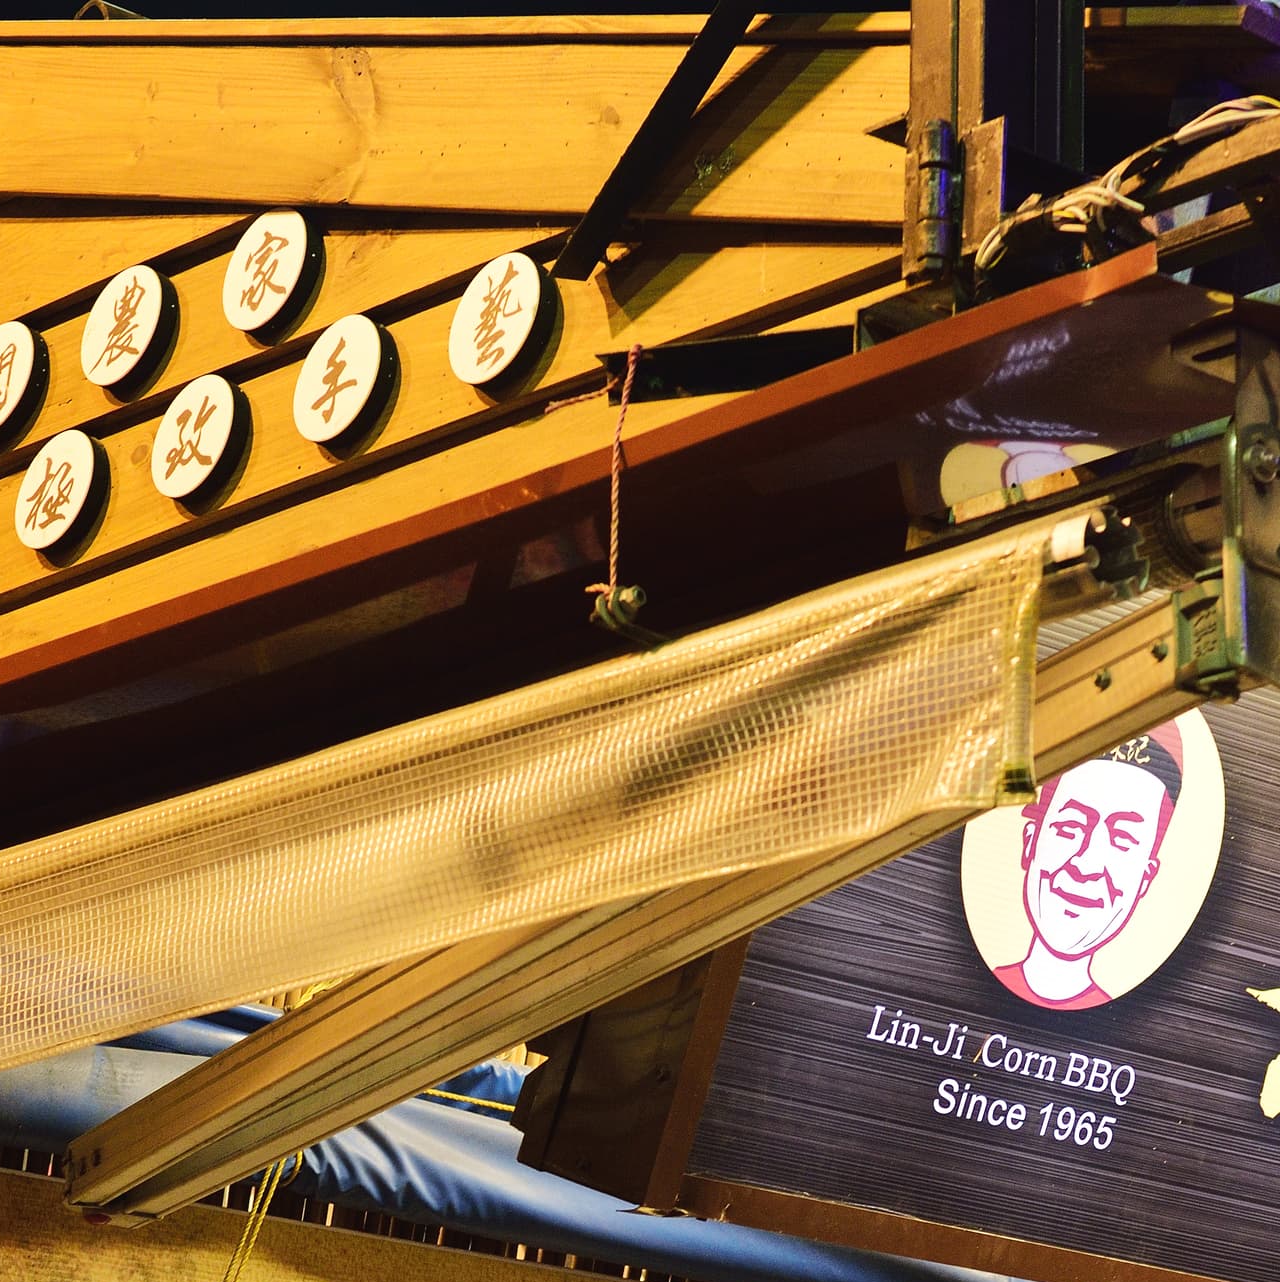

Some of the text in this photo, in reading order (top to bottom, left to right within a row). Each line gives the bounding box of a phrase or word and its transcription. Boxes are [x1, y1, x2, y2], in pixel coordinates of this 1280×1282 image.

[1101, 735, 1151, 764] 記
[866, 1004, 1138, 1106] Lin-Ji Corn BBQ
[931, 1077, 1117, 1150] Since 1965
